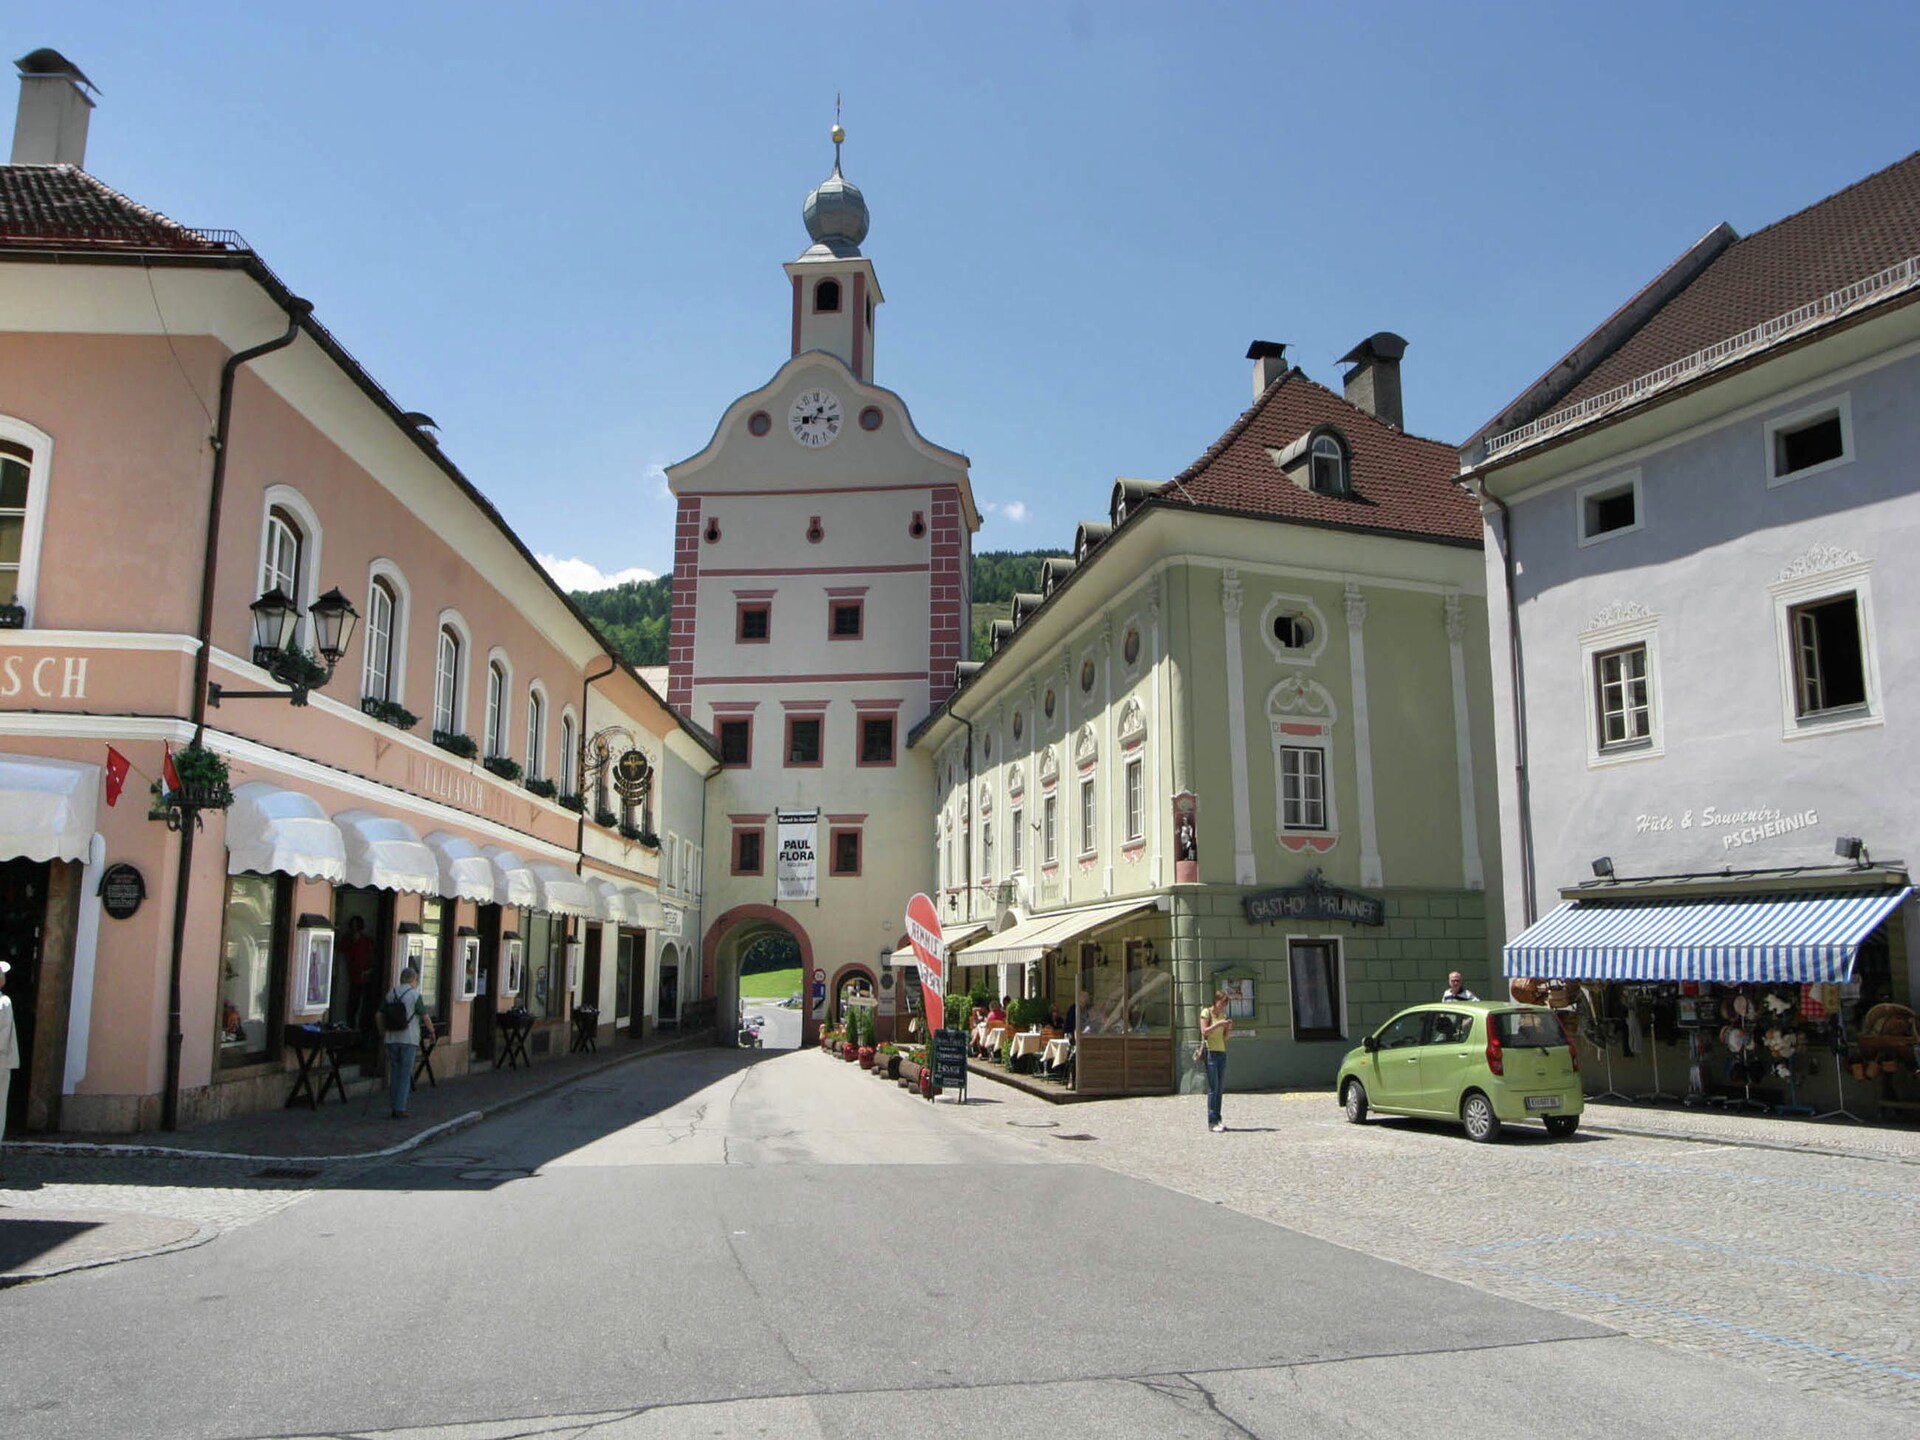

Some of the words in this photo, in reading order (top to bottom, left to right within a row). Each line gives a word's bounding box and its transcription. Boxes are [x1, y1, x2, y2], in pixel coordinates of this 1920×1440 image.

[1, 655, 88, 698] SCH
[1635, 814, 1674, 834] Hüte
[1681, 809, 1693, 829] &
[1701, 804, 1781, 828] Souvenirs
[1722, 810, 1819, 850] PSCHERNIG
[779, 851, 815, 861] FLORA
[784, 840, 811, 849] PAUL
